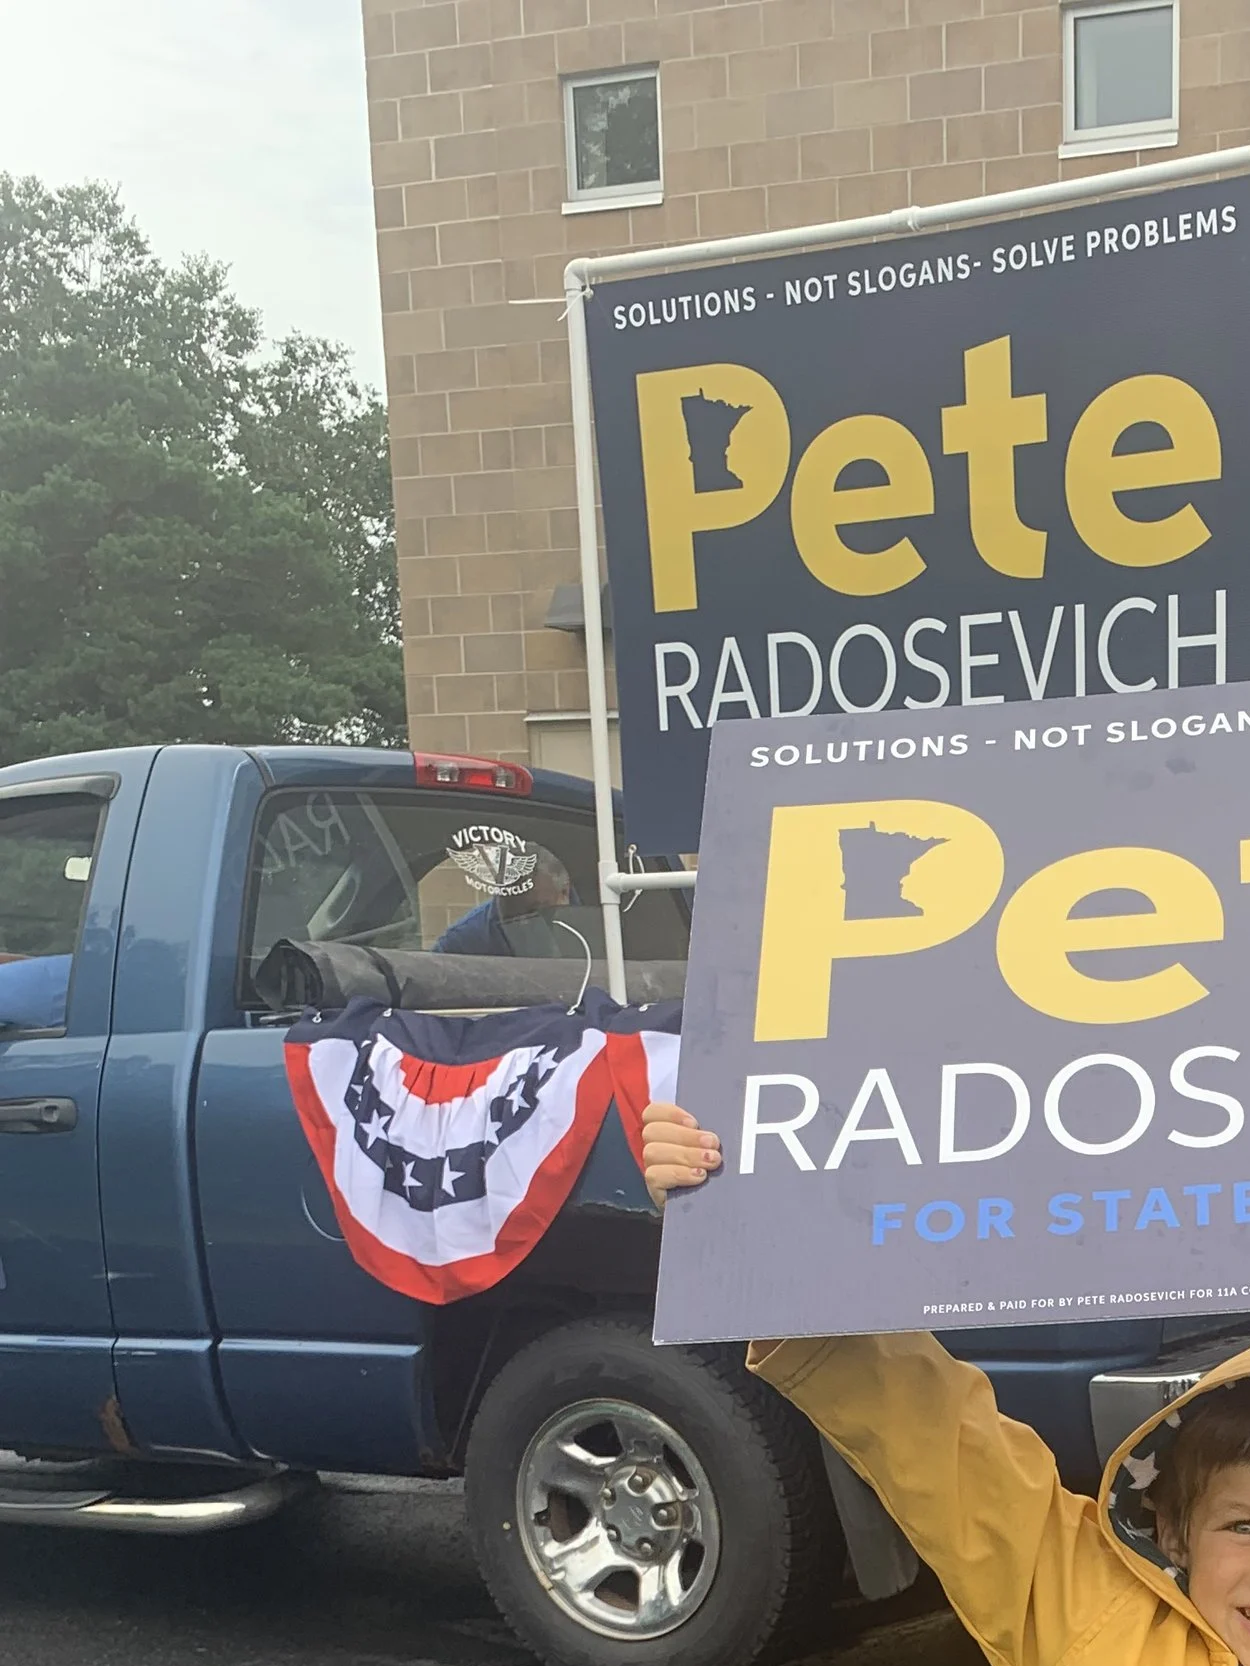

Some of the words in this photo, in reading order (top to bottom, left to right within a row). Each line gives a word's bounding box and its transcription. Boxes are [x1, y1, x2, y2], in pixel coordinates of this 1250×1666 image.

[613, 286, 756, 330] SOLUTIONS
[784, 274, 838, 306] NOT
[847, 253, 982, 297] SLOGANS-
[992, 234, 1075, 274] SOLVE
[1086, 205, 1237, 258] PROBLEMS
[636, 334, 1222, 613] Pete
[655, 589, 1227, 732] RADOSEVICH
[749, 733, 969, 769] SOLUTIONS
[1014, 723, 1093, 751] NOT
[452, 825, 526, 853] VICTORY
[465, 875, 534, 896] MOTORCYCLES
[871, 1198, 1014, 1246] FOR
[923, 1303, 983, 1315] PREPARED
[987, 1302, 996, 1312] &
[999, 1300, 1027, 1311] PAID
[1031, 1298, 1055, 1309] FOR
[1059, 1297, 1074, 1307] BY
[1077, 1295, 1106, 1306] PETE
[1110, 1290, 1185, 1304] RADOSEVICH
[1189, 1288, 1213, 1299] FOR
[1217, 1287, 1238, 1298] 11A
